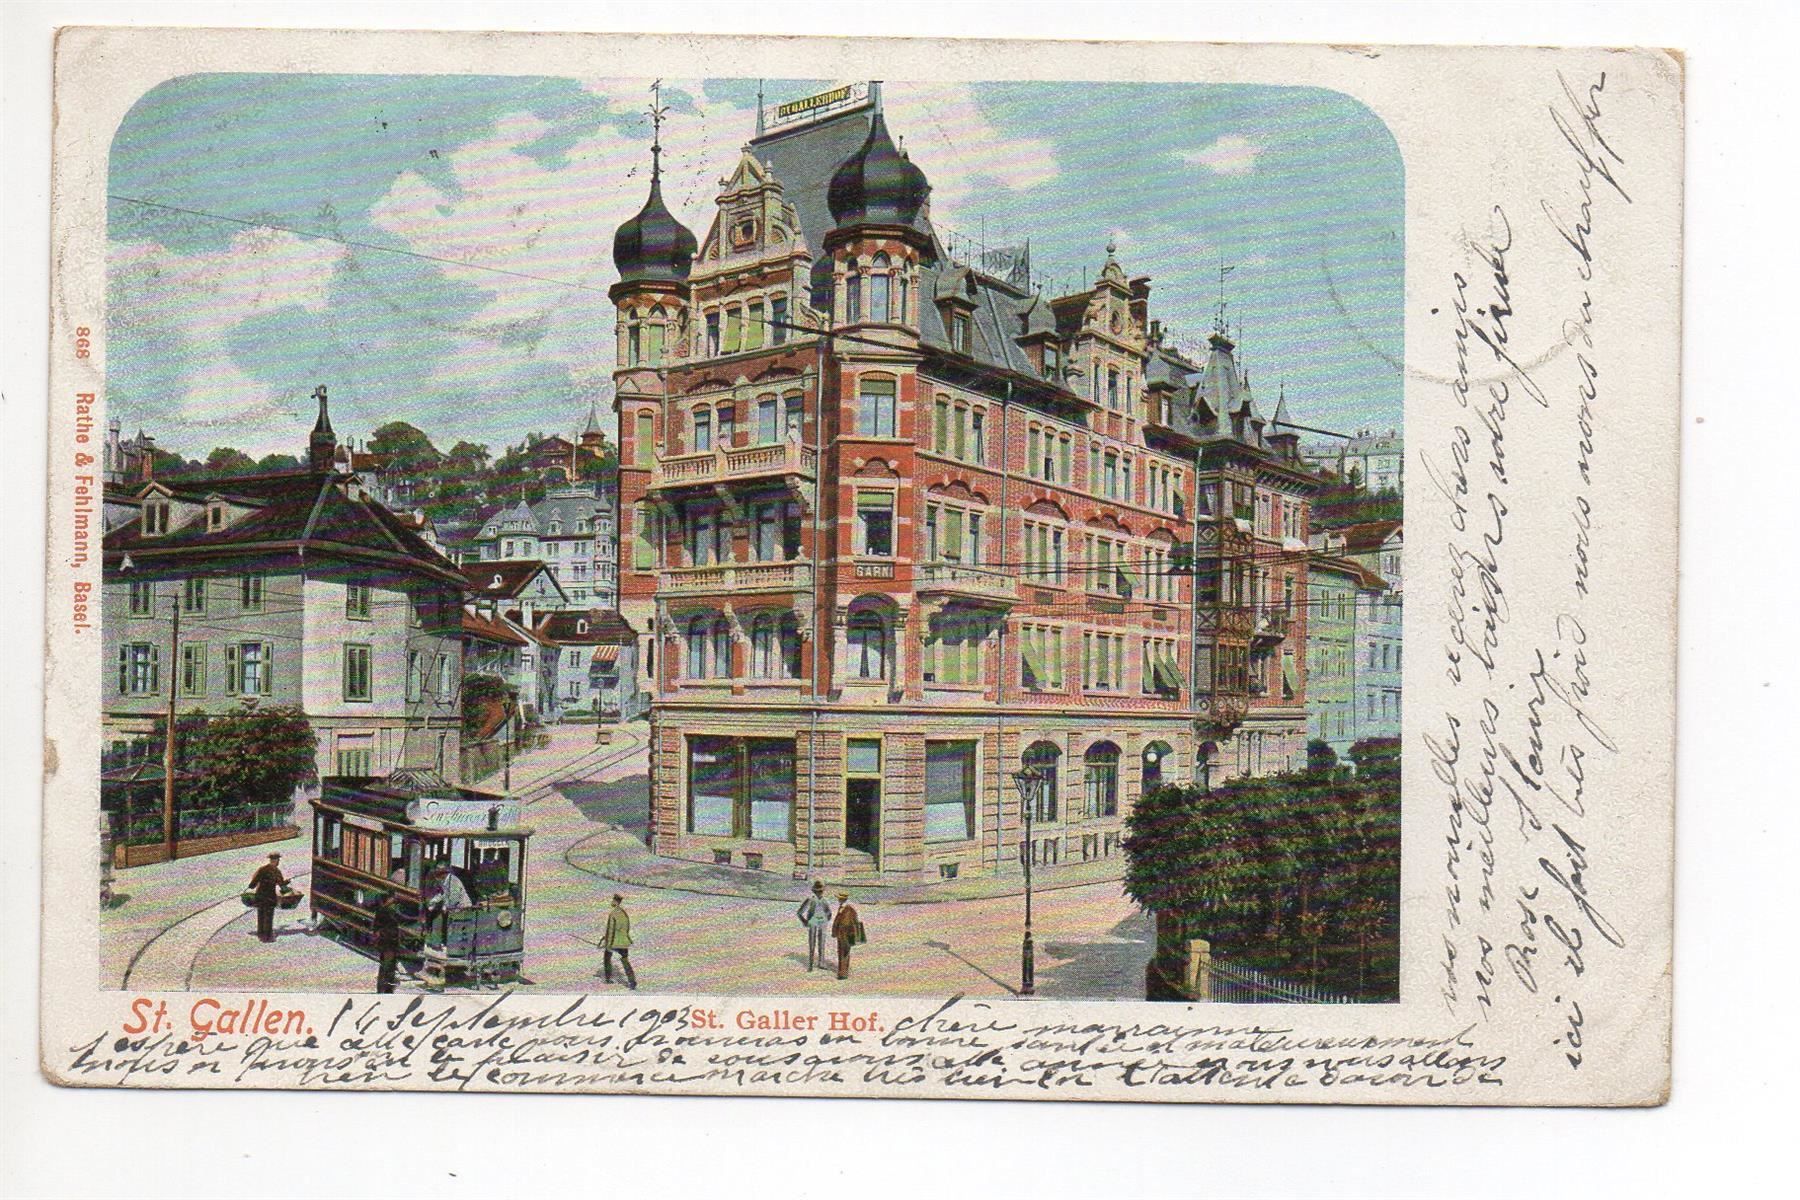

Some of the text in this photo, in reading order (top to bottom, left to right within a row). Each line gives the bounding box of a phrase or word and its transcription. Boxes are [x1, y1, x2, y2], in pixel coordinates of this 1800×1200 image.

[1436, 272, 1468, 408] amis
[71, 326, 95, 635] 868 Rathe & Fehlmann, Basel.
[856, 566, 894, 578] GARNI
[1539, 823, 1625, 948] fait
[123, 998, 313, 1042] St. Gallen.
[691, 1009, 884, 1032] St. Galler Hof.
